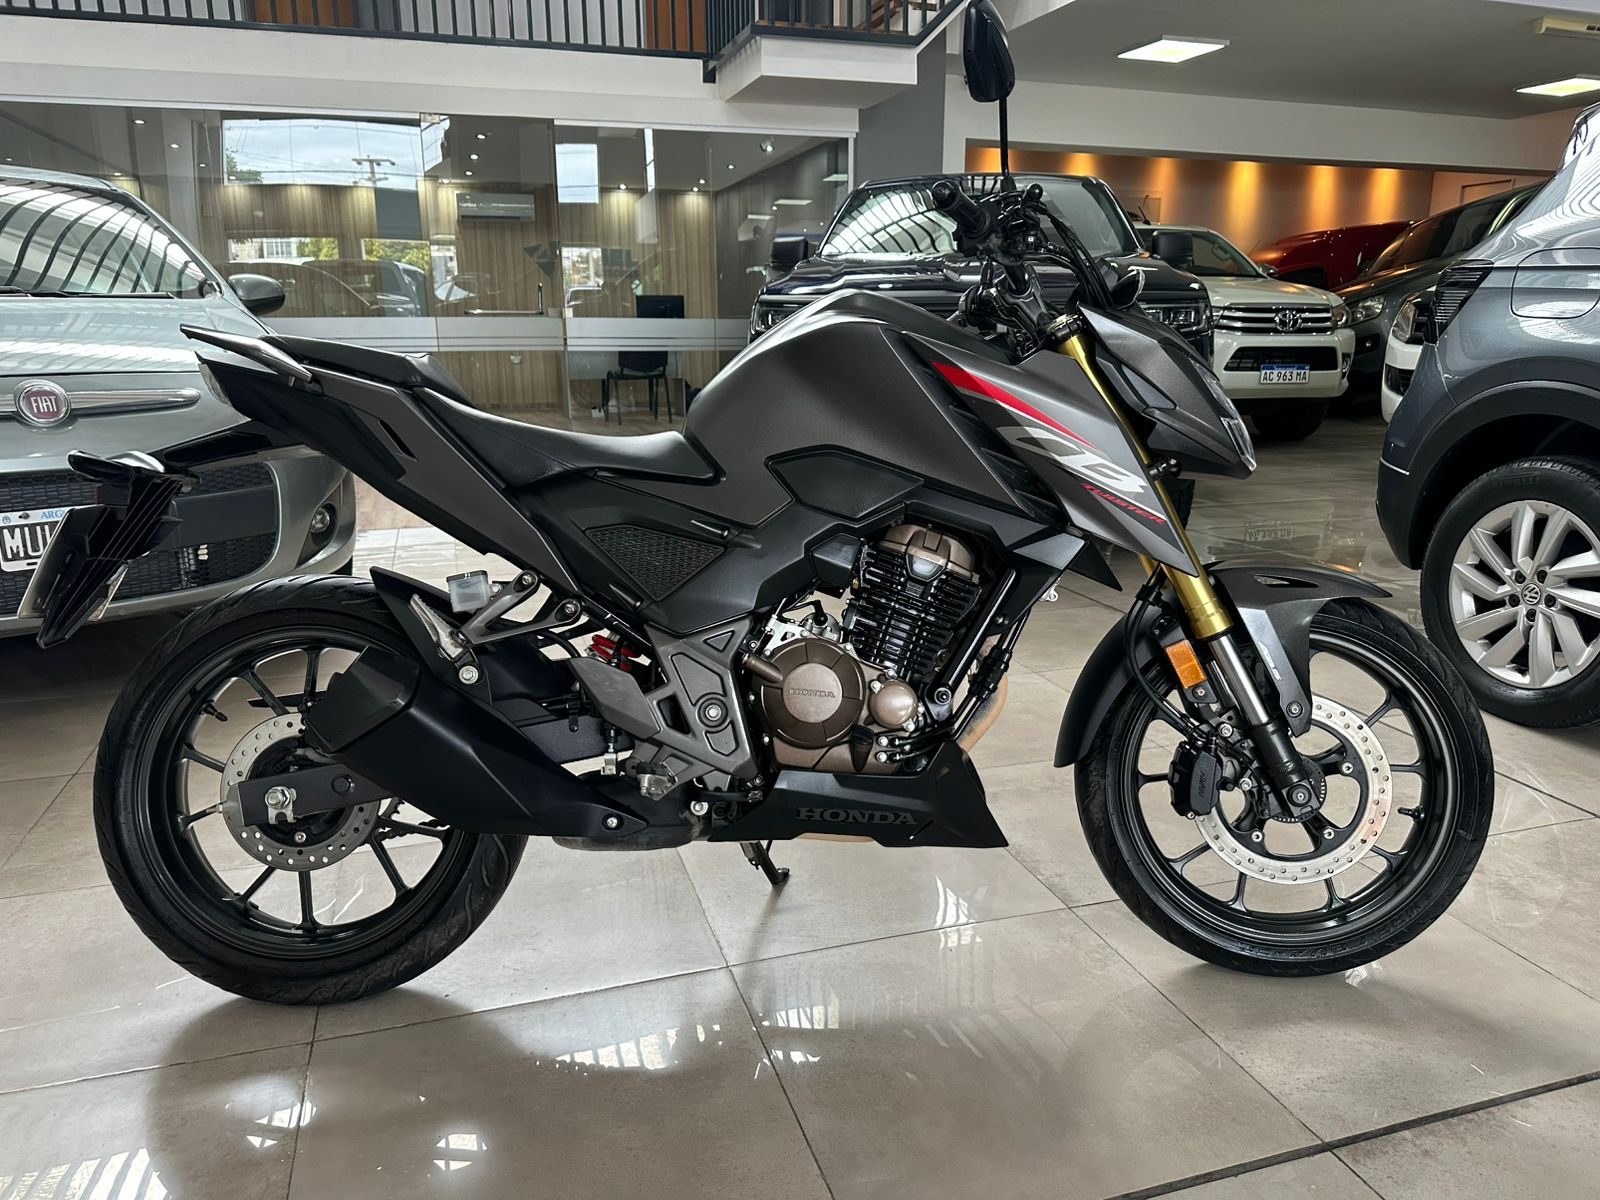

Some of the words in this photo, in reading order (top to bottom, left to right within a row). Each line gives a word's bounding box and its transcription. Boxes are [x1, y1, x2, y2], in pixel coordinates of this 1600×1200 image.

[1263, 371, 1274, 382] AC
[1277, 371, 1294, 382] 963
[1296, 371, 1307, 382] MA
[30, 395, 58, 413] FIAT
[790, 688, 836, 699] HONDA
[797, 807, 918, 825] HONDA
